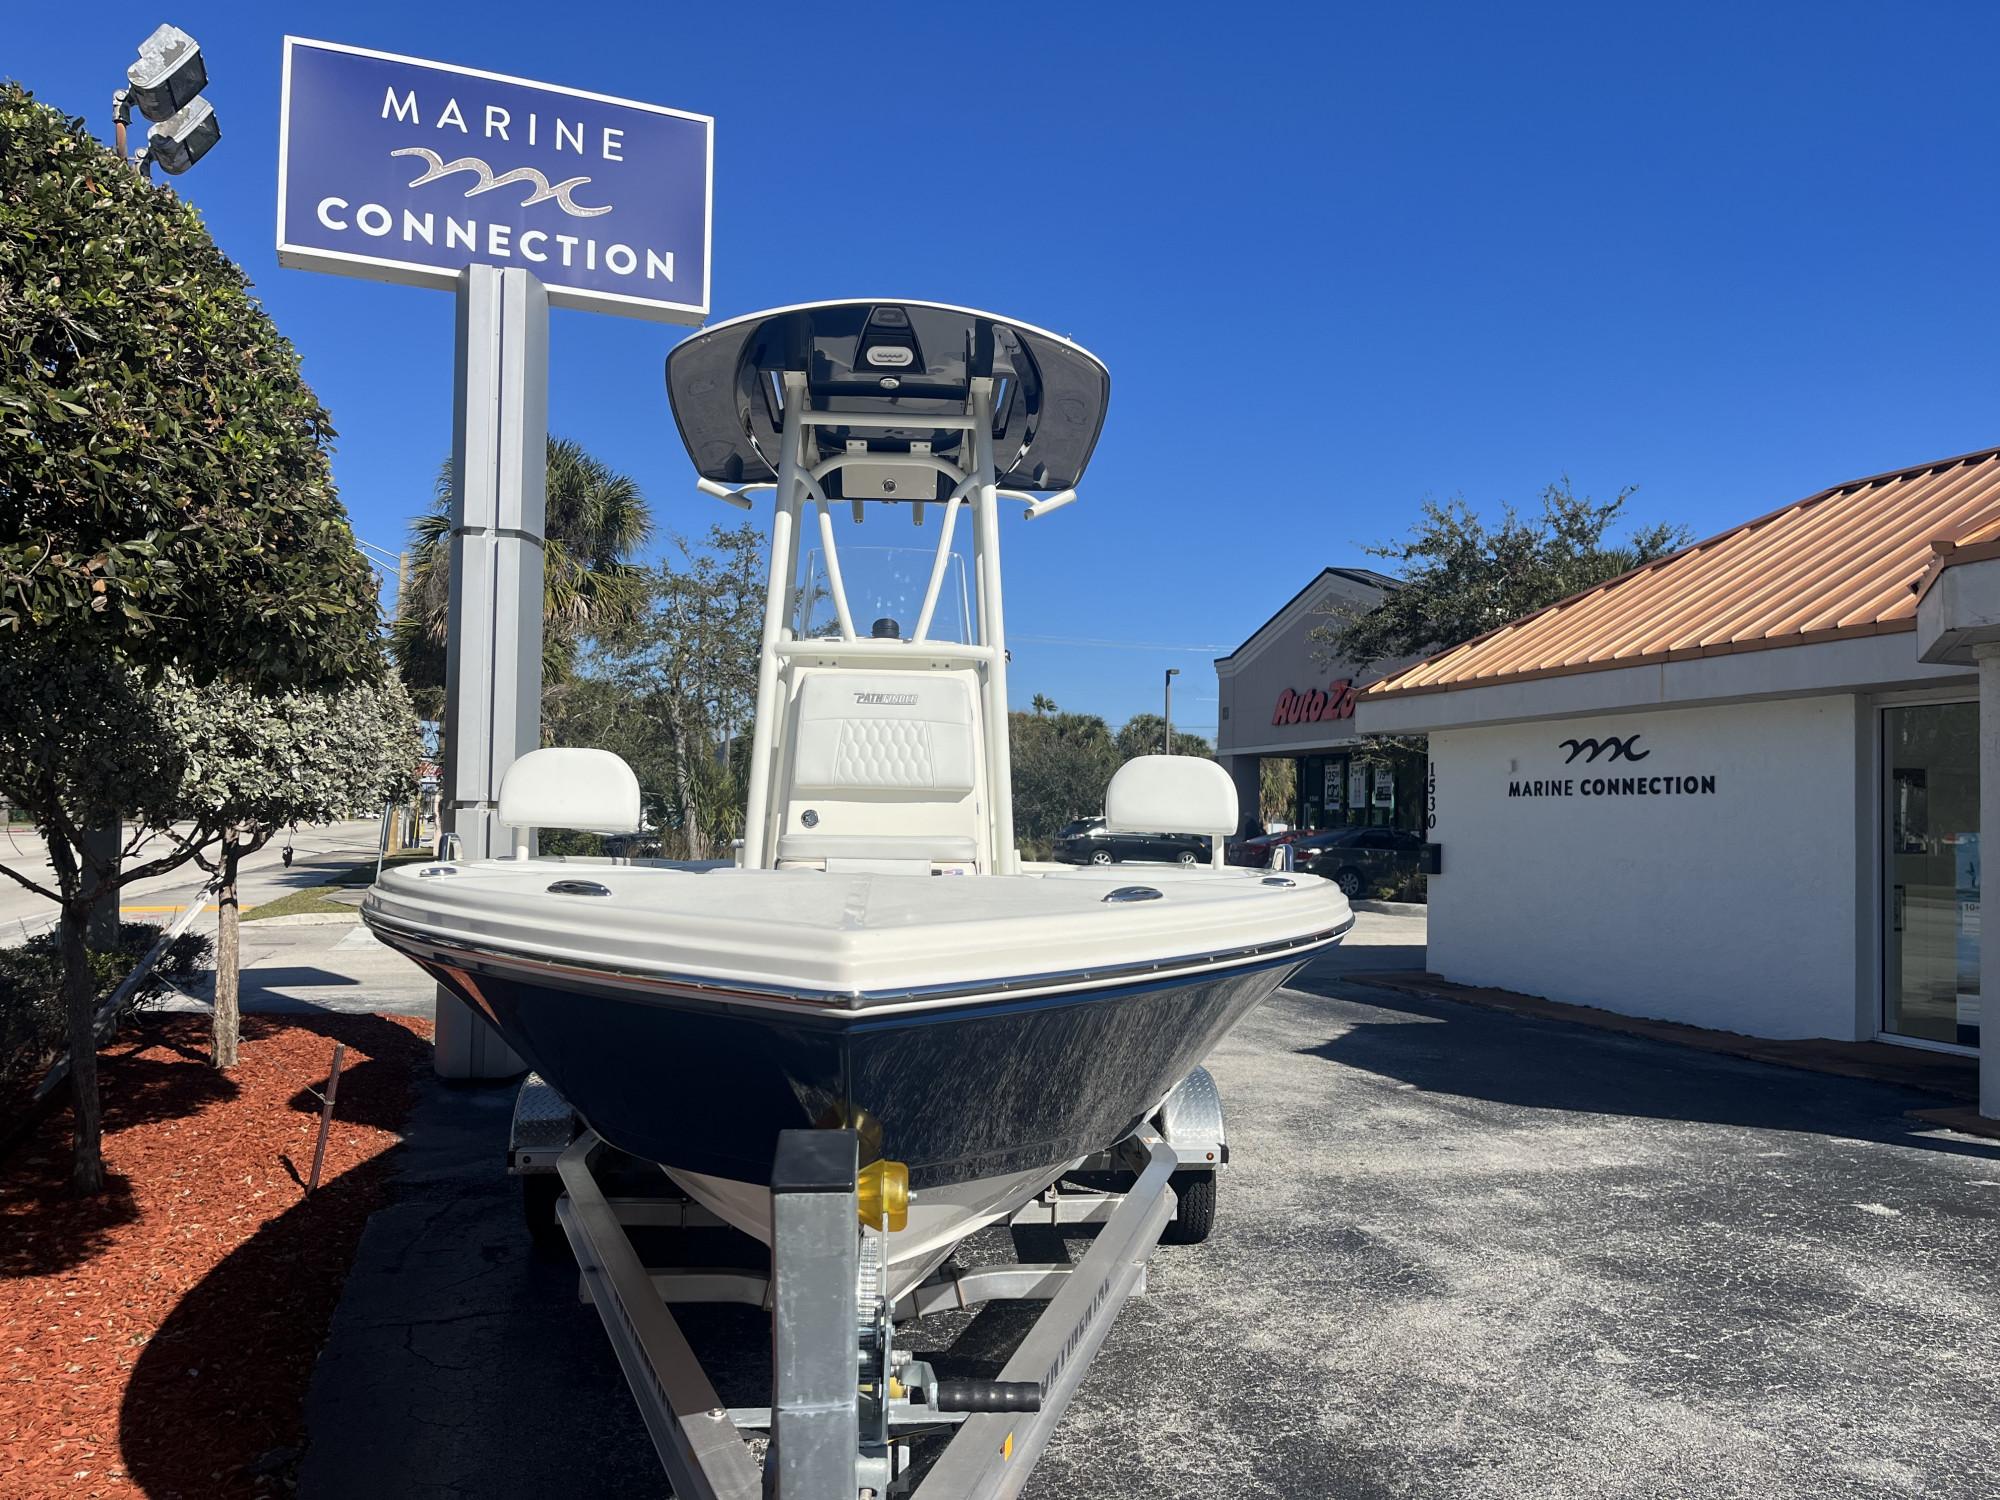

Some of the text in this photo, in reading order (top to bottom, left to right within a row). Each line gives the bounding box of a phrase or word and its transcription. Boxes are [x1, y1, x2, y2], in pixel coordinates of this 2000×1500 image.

[382, 86, 624, 162] MARINE
[317, 197, 674, 282] CONNECTION
[1272, 679, 1356, 725] AutoZo
[1427, 761, 1437, 829] 1530
[1508, 775, 1715, 797] MARINE CONNECTION
